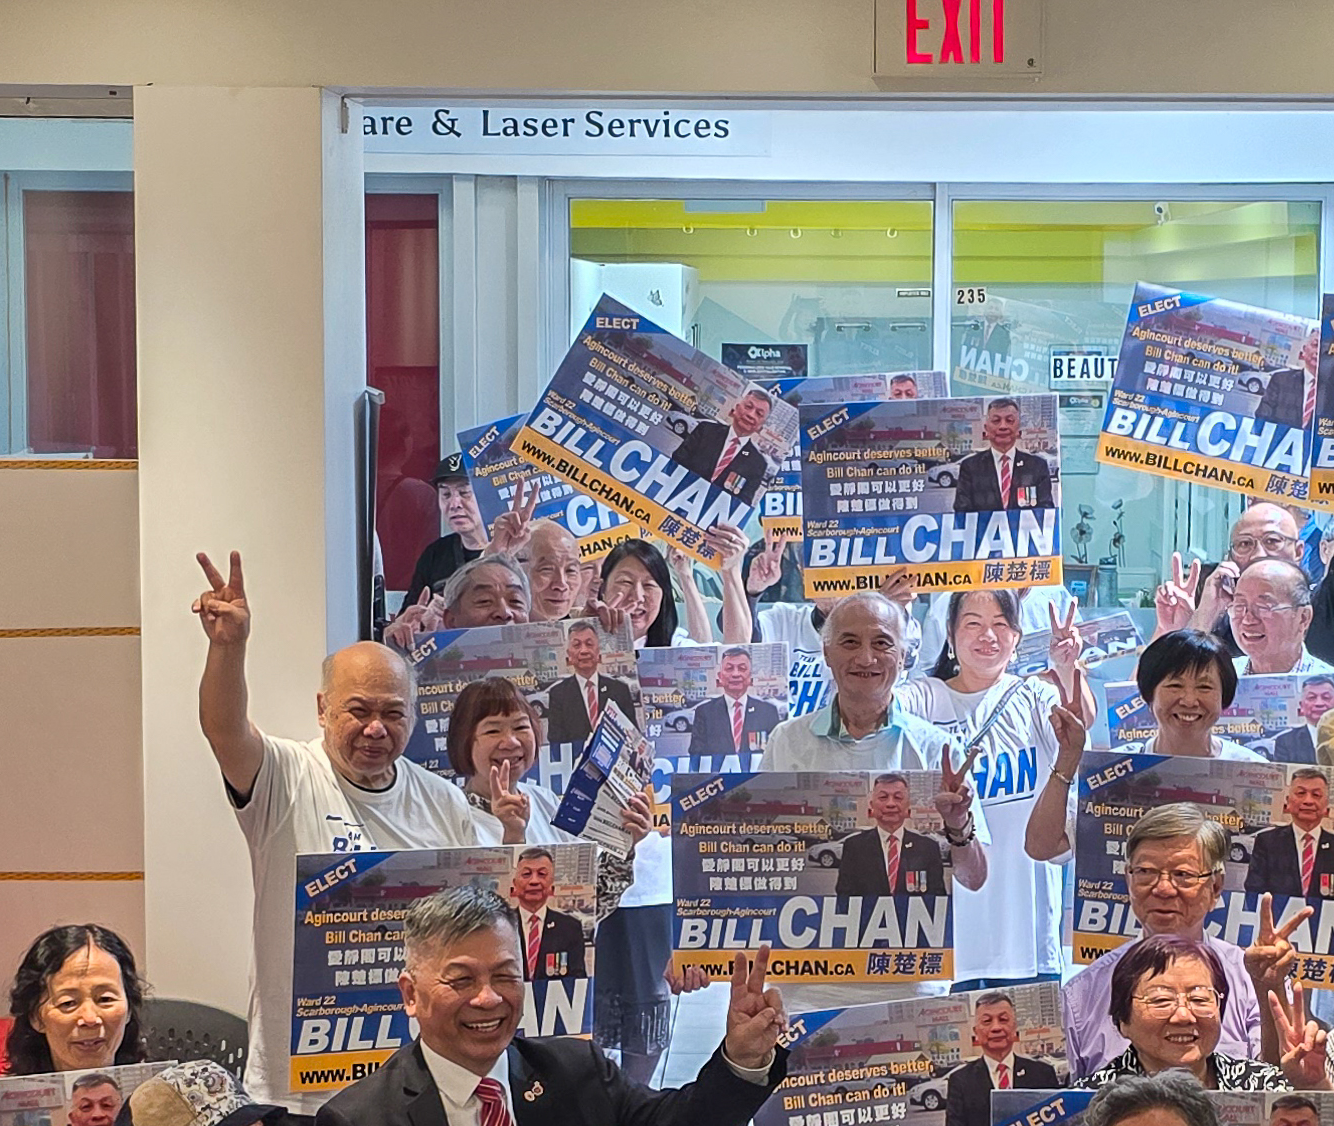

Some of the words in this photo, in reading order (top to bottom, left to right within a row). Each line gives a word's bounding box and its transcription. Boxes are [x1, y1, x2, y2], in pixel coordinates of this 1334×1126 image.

[431, 109, 462, 138] &
[482, 110, 575, 137] Laser
[585, 110, 730, 138] Services
[956, 288, 986, 304] 235
[1138, 296, 1182, 317] ELECT
[595, 318, 640, 329] ELECT
[807, 407, 850, 441] ELECT
[1106, 408, 1190, 450] BILL
[529, 408, 605, 468] BILL
[809, 449, 861, 463] Agincourt
[864, 447, 911, 460] deserves
[810, 537, 896, 567] BILL
[901, 509, 1056, 562] CHAN
[982, 559, 1052, 583] 陳楚標
[789, 662, 822, 679] BILL
[1086, 758, 1134, 790] ELECT
[679, 777, 725, 812] ELECT
[1086, 802, 1143, 820] Agincourt
[681, 823, 736, 836] Agincourt
[794, 822, 831, 835] better,
[720, 841, 750, 853] Chan
[304, 858, 358, 898] ELECT
[305, 908, 367, 926] Agincourt
[679, 919, 772, 948] BILL
[778, 895, 948, 949] CHAN
[325, 930, 345, 945] Bill
[867, 952, 943, 975] 陳楚標
[297, 1014, 402, 1054] BILL
[828, 1063, 887, 1084] deserves
[890, 1057, 933, 1077] better,
